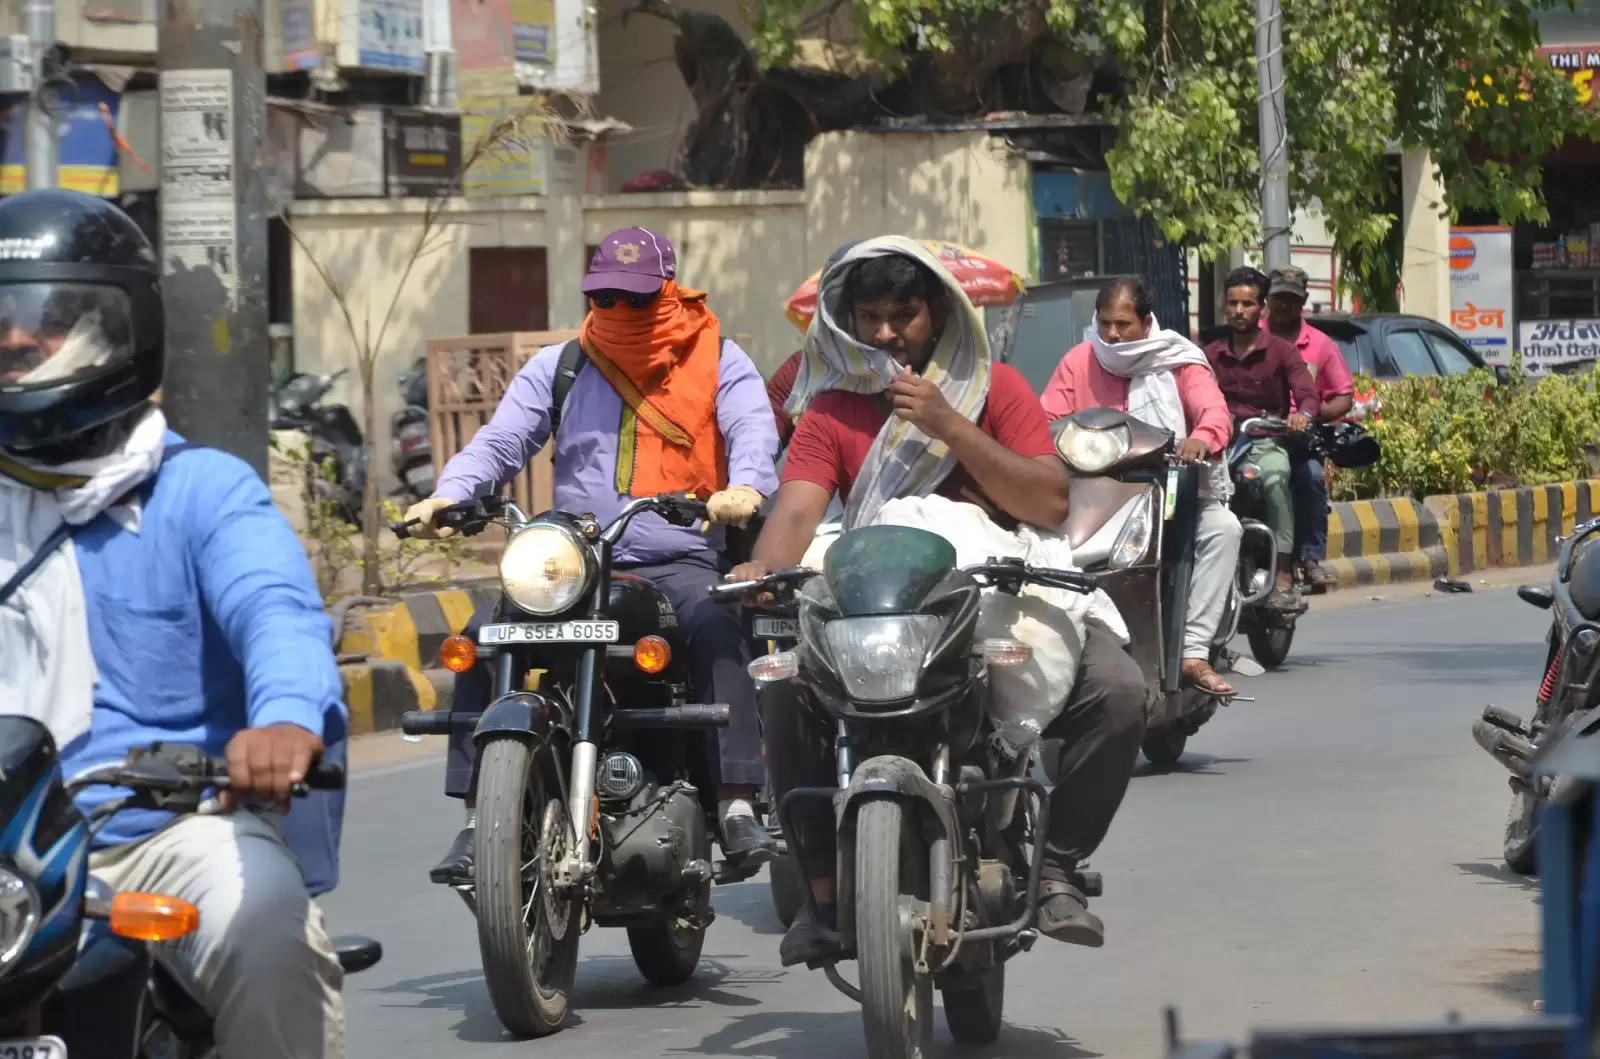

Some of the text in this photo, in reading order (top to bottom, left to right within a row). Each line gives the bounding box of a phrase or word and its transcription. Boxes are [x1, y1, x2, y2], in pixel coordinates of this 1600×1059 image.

[1550, 54, 1579, 67] THE
[497, 624, 614, 640] UP 65EA 6055
